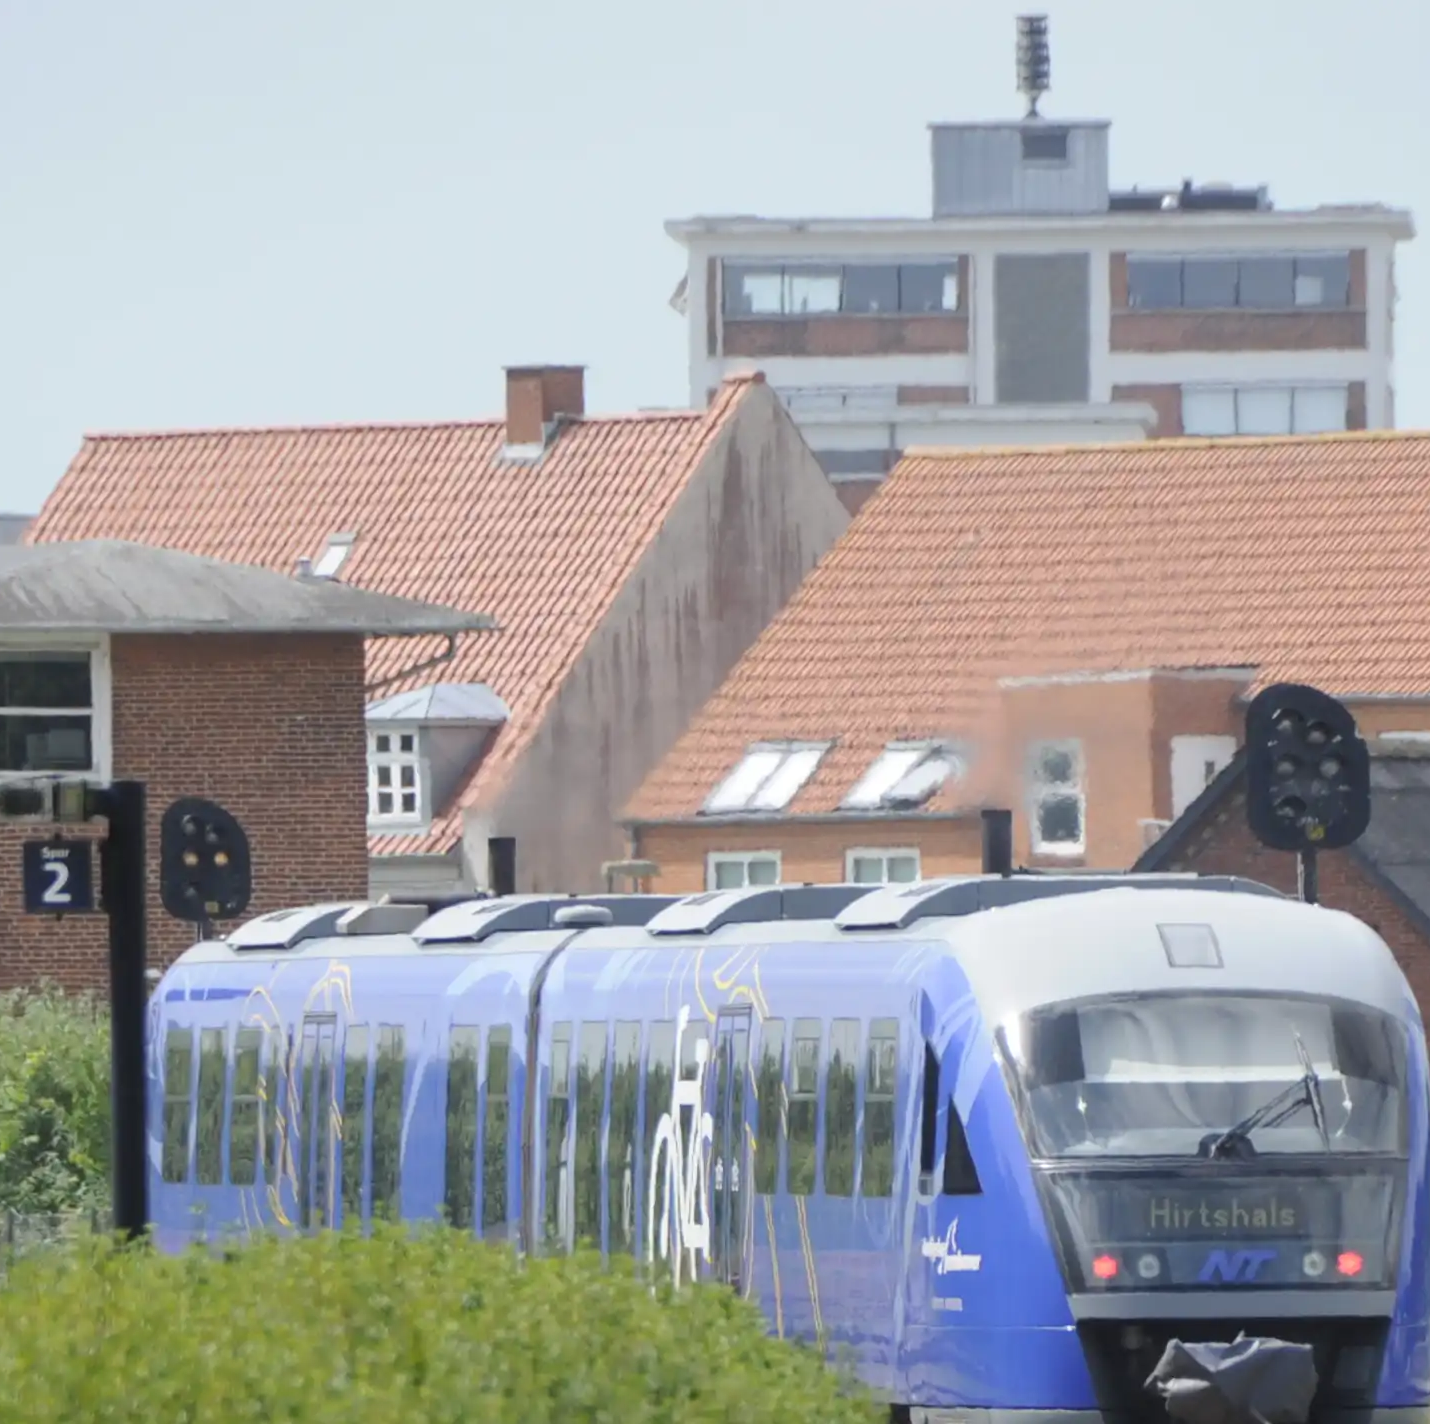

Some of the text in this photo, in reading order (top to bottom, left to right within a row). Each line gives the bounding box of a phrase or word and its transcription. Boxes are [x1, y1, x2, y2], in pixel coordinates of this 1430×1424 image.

[42, 862, 71, 903] 2
[1150, 1198, 1296, 1229] Hirtshals
[1197, 1248, 1278, 1282] NT
